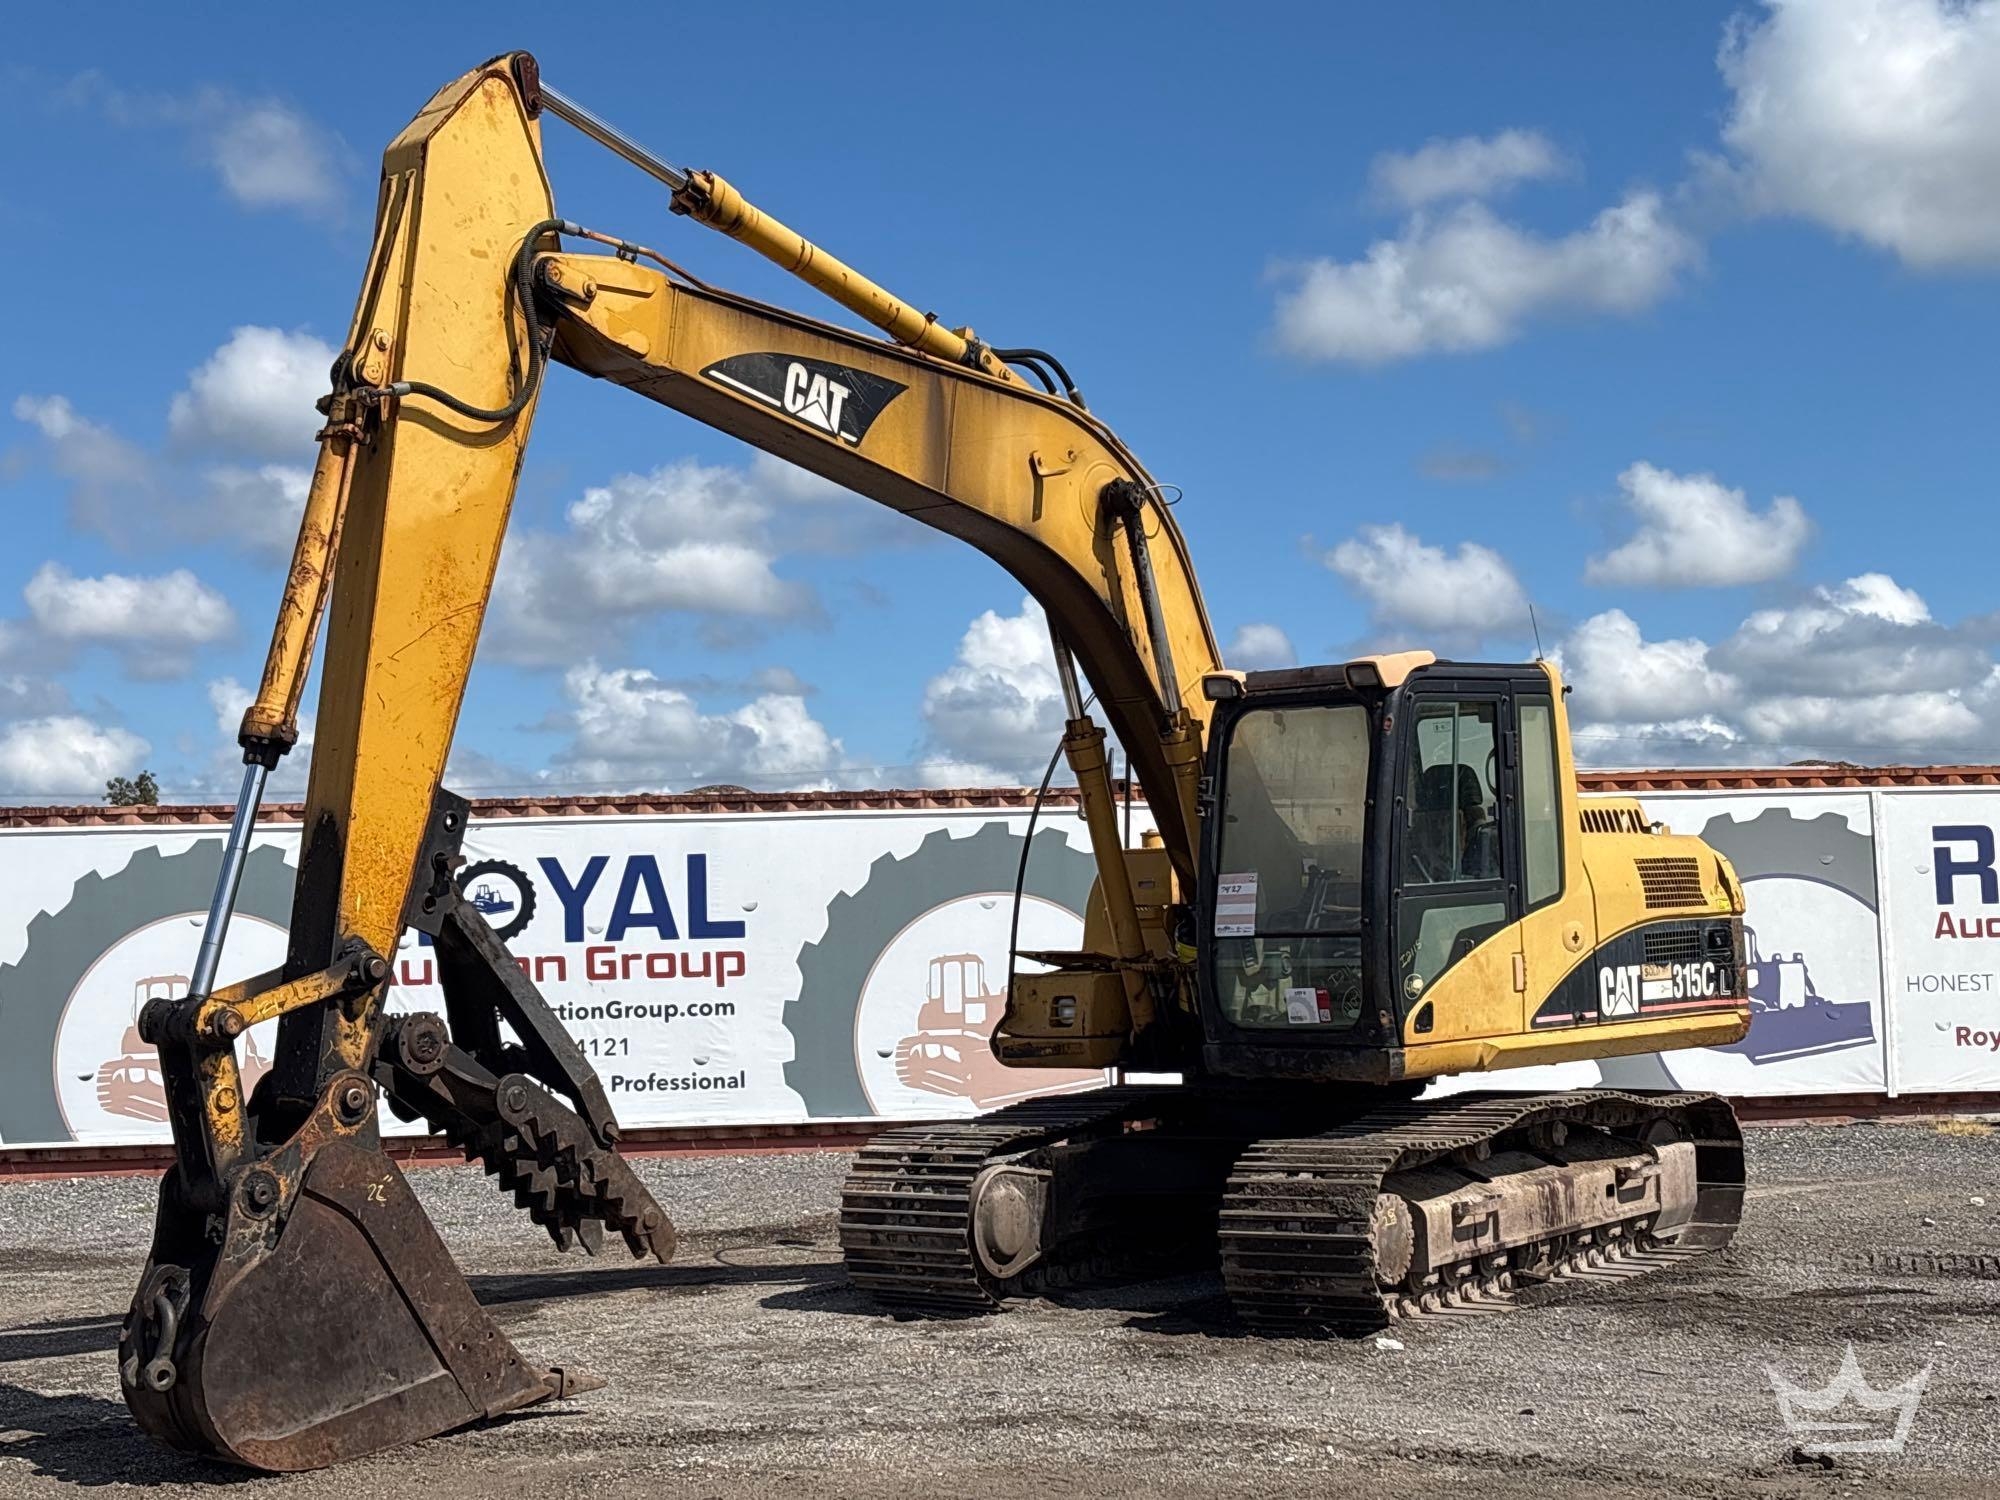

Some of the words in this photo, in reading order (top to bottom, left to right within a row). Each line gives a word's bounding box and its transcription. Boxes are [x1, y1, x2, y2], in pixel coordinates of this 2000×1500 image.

[784, 362, 851, 434] CAT
[586, 946, 746, 988] Group
[1907, 974, 1994, 992] HONEST
[1600, 964, 1641, 1016] CAT
[1673, 962, 1715, 998] 315C
[553, 1001, 735, 1023] tionGroup.com
[611, 1070, 746, 1093] Professional
